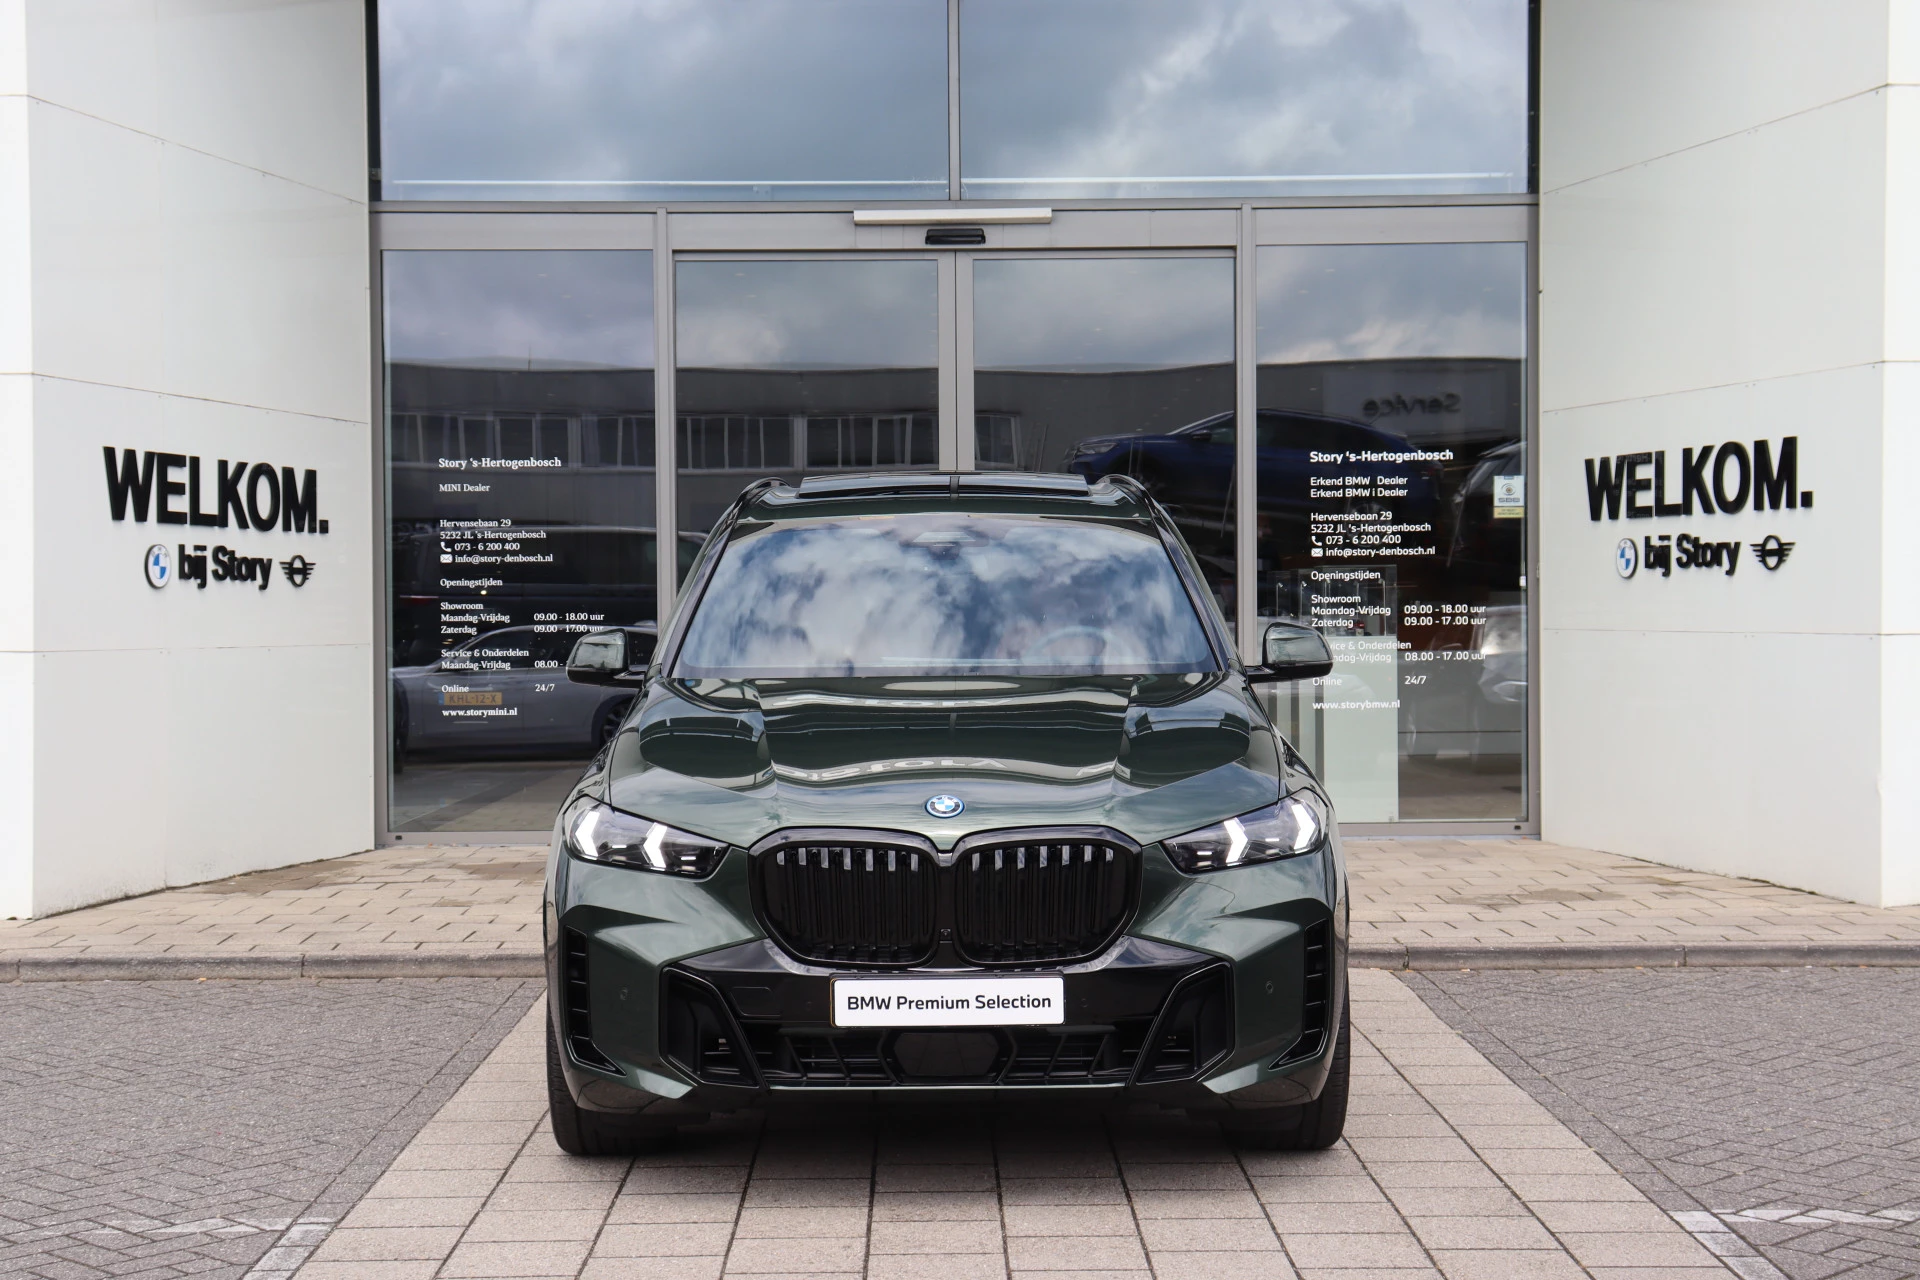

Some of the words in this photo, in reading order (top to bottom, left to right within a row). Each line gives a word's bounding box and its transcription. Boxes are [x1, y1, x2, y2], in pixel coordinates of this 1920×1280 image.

[1310, 451, 1343, 464] Story
[438, 457, 467, 470] Story
[1310, 477, 1343, 486] Erkend
[1345, 477, 1371, 486] BMW
[1377, 476, 1409, 485] Dealer
[1584, 436, 1813, 521] WELKOM.
[103, 446, 329, 534] WELKOM.
[439, 483, 462, 492] MINI
[463, 483, 491, 492] Dealer
[1310, 488, 1343, 498] Erkend
[1345, 488, 1371, 497] BMW
[1377, 487, 1409, 497] Dealer
[1311, 512, 1378, 522] Hervensebaan
[1380, 511, 1393, 521] 29
[440, 519, 498, 528] Hervensebaan
[500, 519, 512, 528] 29
[1311, 523, 1334, 533] 5232
[1335, 523, 1347, 533] JL
[440, 531, 462, 540] 5232
[463, 531, 474, 540] JL
[1326, 535, 1343, 545] 073
[1352, 535, 1359, 545] 6
[1361, 535, 1380, 544] 200
[1382, 534, 1402, 544] 400
[454, 542, 471, 551] 073
[478, 542, 485, 551] 6
[486, 542, 502, 551] 200
[503, 542, 520, 551] 400
[1326, 545, 1436, 558] info@story-denbosch.nl
[454, 554, 553, 565] info@story-denbosch.nl
[1644, 535, 1672, 577] bij
[1676, 533, 1741, 576] Story
[178, 544, 207, 590] bij
[211, 545, 273, 590] Story
[1311, 570, 1381, 581] Openingstijden
[440, 578, 503, 588] Openingstijden
[1311, 594, 1362, 604] Showroom
[440, 602, 484, 610] Showroom
[1311, 605, 1392, 617] Maandag-Vrijdag
[1404, 605, 1433, 615] 09.00
[1441, 604, 1469, 614] 18.00
[1470, 606, 1487, 614] uur
[441, 613, 511, 624] Maandag-Vrijdag
[534, 613, 558, 621] 09.00
[565, 612, 588, 621] 18.00
[589, 613, 605, 621] uur
[1311, 617, 1354, 629] Zaterdag
[1404, 616, 1433, 626] 09.00
[1441, 616, 1469, 626] 17.00
[1470, 617, 1487, 626] uur
[441, 625, 478, 635] Zaterdag
[534, 625, 558, 633] 09.00
[565, 624, 588, 633] 17.00
[589, 625, 604, 633] uur
[1330, 642, 1346, 650] vice
[1348, 641, 1356, 650] &
[1358, 640, 1412, 650] Onderdelen
[441, 648, 472, 658] Service
[473, 649, 480, 658] &
[481, 648, 530, 658] Onderdelen
[1333, 652, 1392, 664] ndag-Vrijdag
[1404, 651, 1433, 662] 08.00
[1442, 651, 1469, 661] 17.00
[1471, 653, 1486, 661] uur
[441, 660, 511, 671] Maandag-Vrijdag
[534, 660, 558, 669] 08.00
[1312, 677, 1343, 686] Online
[1404, 675, 1427, 685] 24/7
[441, 684, 470, 693] Online
[535, 683, 556, 692] 24/7
[1312, 699, 1401, 710] www.storybmw.nl
[442, 707, 518, 718] www.storymini.nl
[847, 996, 891, 1010] BMW
[897, 995, 970, 1010] Premium
[975, 994, 1052, 1009] Selection
